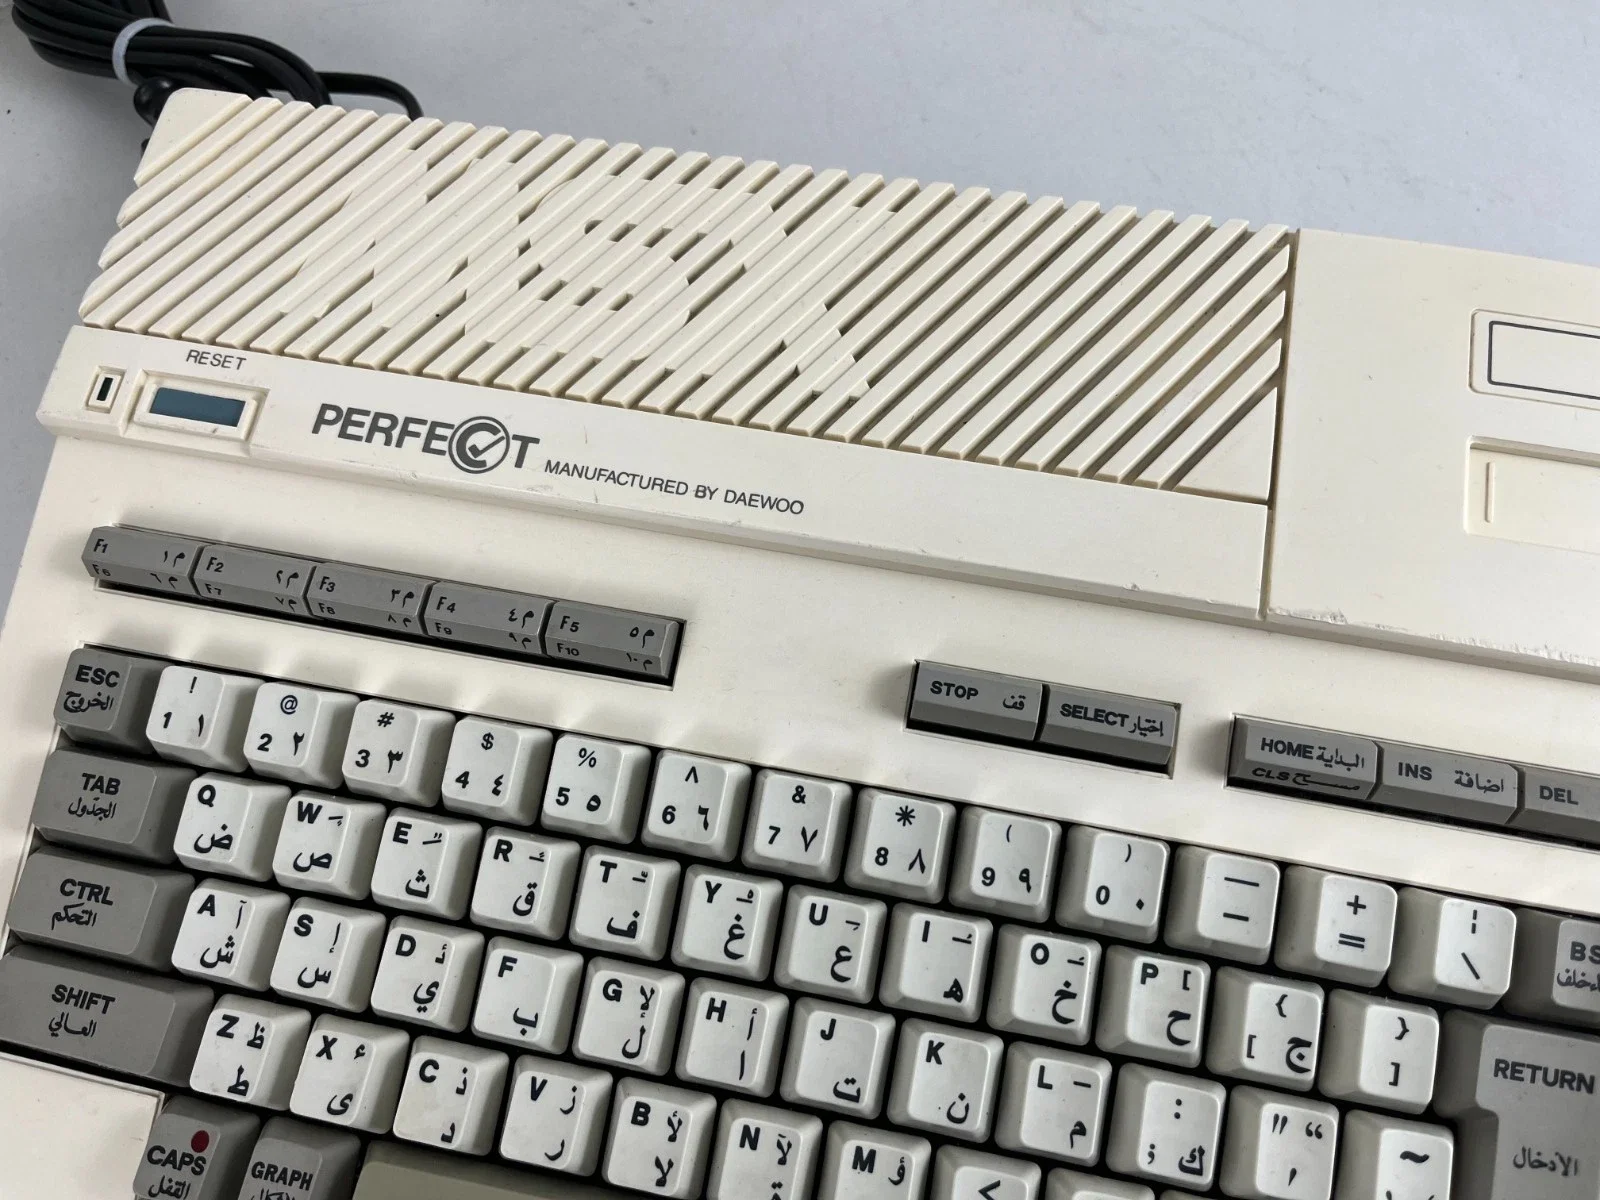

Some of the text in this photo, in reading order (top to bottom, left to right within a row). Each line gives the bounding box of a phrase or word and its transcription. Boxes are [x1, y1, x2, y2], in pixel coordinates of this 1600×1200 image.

[186, 347, 249, 369] RESET
[311, 402, 541, 475] PERFECT
[545, 460, 804, 514] MANUFACTURED BY DAEWOO
[94, 539, 108, 553] F1
[207, 557, 223, 572] F2
[205, 584, 221, 595] F7
[320, 576, 335, 592] F3
[316, 603, 335, 616] F8
[437, 597, 455, 613] F4
[435, 623, 452, 635] F9
[560, 616, 579, 632] F5
[557, 643, 579, 656] F10
[75, 665, 119, 687] ESC
[190, 677, 197, 693] !
[930, 681, 978, 700] STOP
[64, 691, 113, 713] الخروج
[280, 695, 298, 715] @
[1003, 695, 1026, 710] قف
[164, 712, 172, 728] 1
[377, 712, 394, 727] #
[1060, 704, 1129, 727] SELECT
[1128, 716, 1163, 737] اختيار
[258, 734, 272, 751] 2
[293, 732, 304, 755] ٢
[481, 733, 494, 750] $
[1261, 738, 1314, 759] HOME
[355, 749, 370, 767] 3
[388, 750, 403, 773] ٣
[579, 748, 596, 767] %
[1316, 746, 1364, 771] البداية
[456, 771, 469, 788] 4
[1250, 768, 1289, 784] CLS
[1399, 762, 1432, 780] INS
[82, 773, 120, 795] TAB
[492, 775, 503, 796] ٤
[792, 785, 806, 804] &
[198, 785, 216, 807] Q
[556, 787, 570, 806] 5
[587, 795, 601, 811] ٥
[1540, 786, 1578, 805] DEL
[298, 801, 322, 824] W
[662, 806, 676, 824] 6
[698, 806, 709, 830] ٦
[194, 824, 233, 853] ض
[393, 822, 412, 844] E
[769, 826, 780, 844] 7
[801, 827, 818, 852] ٧
[494, 839, 512, 862] R
[875, 847, 888, 866] 8
[909, 849, 925, 874] ٨
[293, 853, 332, 872] ص
[600, 861, 617, 883] T
[405, 869, 429, 898] ث
[982, 867, 995, 886] 9
[1019, 868, 1031, 893] ٩
[60, 879, 113, 908] CTRL
[513, 883, 537, 916] ق
[706, 881, 722, 903] Y
[52, 900, 99, 930] التحكم
[197, 895, 215, 916] A
[236, 900, 247, 928] آ
[809, 903, 828, 925] U
[1347, 895, 1366, 915] +
[294, 914, 313, 936] S
[607, 911, 640, 939] ف
[330, 923, 340, 953] إ
[396, 934, 416, 956] D
[724, 914, 745, 960] غ
[1339, 934, 1365, 948] =
[200, 935, 235, 968] ش
[1031, 943, 1049, 965] O
[1571, 942, 1600, 964] BS
[498, 956, 517, 977] F
[831, 946, 852, 982] ع
[1141, 963, 1158, 984] P
[298, 968, 331, 988] س
[52, 984, 115, 1017] SHIFT
[414, 981, 439, 1013] ي
[603, 979, 622, 1002] G
[706, 998, 726, 1022] H
[1052, 981, 1077, 1024] خ
[49, 1012, 97, 1037] العالي
[217, 1014, 239, 1038] Z
[513, 1008, 538, 1036] ب
[821, 1019, 836, 1040] J
[1167, 1011, 1191, 1046] ح
[247, 1022, 265, 1049] ظ
[622, 1026, 646, 1059] ل
[1247, 1035, 1256, 1058] [
[316, 1036, 337, 1060] X
[926, 1040, 944, 1064] K
[1286, 1037, 1312, 1073] ج
[227, 1065, 249, 1096] ط
[419, 1059, 439, 1083] C
[456, 1067, 467, 1095] ذ
[1038, 1065, 1052, 1089] L
[1494, 1059, 1595, 1094] RETURN
[531, 1076, 547, 1101] V
[833, 1078, 860, 1103] ت
[560, 1086, 577, 1114] ز
[947, 1093, 969, 1124] ن
[1174, 1099, 1182, 1119] :
[631, 1101, 650, 1126] B
[441, 1123, 455, 1143] د
[740, 1125, 760, 1150] N
[1070, 1121, 1086, 1148] م
[147, 1143, 208, 1175] CAPS
[545, 1140, 564, 1161] ر
[852, 1146, 876, 1173] M
[1148, 1144, 1155, 1164] ;
[1179, 1146, 1205, 1176] ك
[252, 1162, 313, 1193] GRAPH
[655, 1157, 673, 1187] لا
[889, 1157, 905, 1185] ؤ
